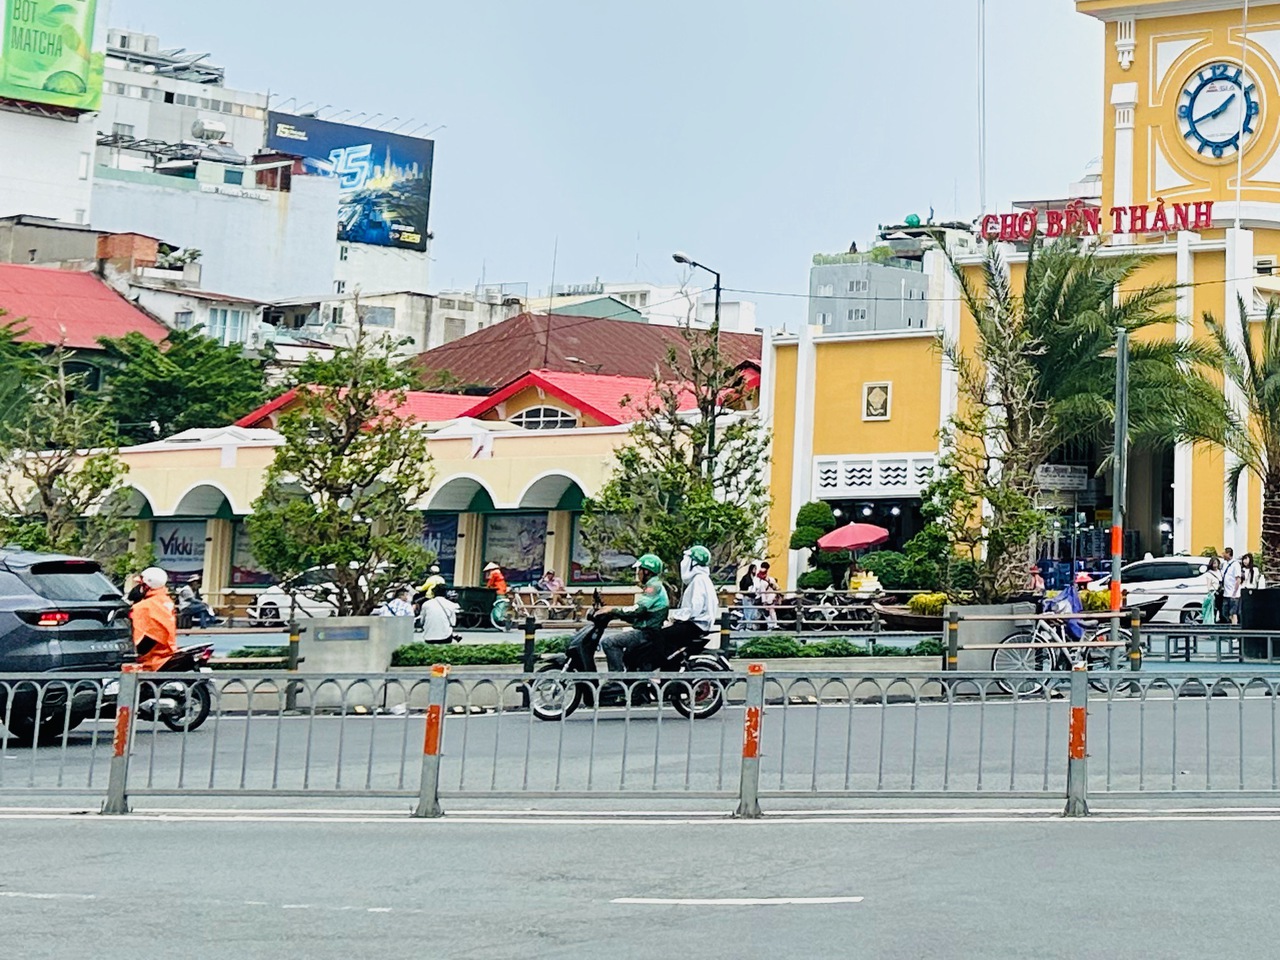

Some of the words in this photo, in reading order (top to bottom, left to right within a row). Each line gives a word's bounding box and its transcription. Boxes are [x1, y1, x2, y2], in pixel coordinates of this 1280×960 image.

[11, 26, 62, 57] MATCHA
[1210, 64, 1228, 79] 12
[1109, 197, 1214, 235] THÀNH
[160, 528, 193, 555] Vikki
